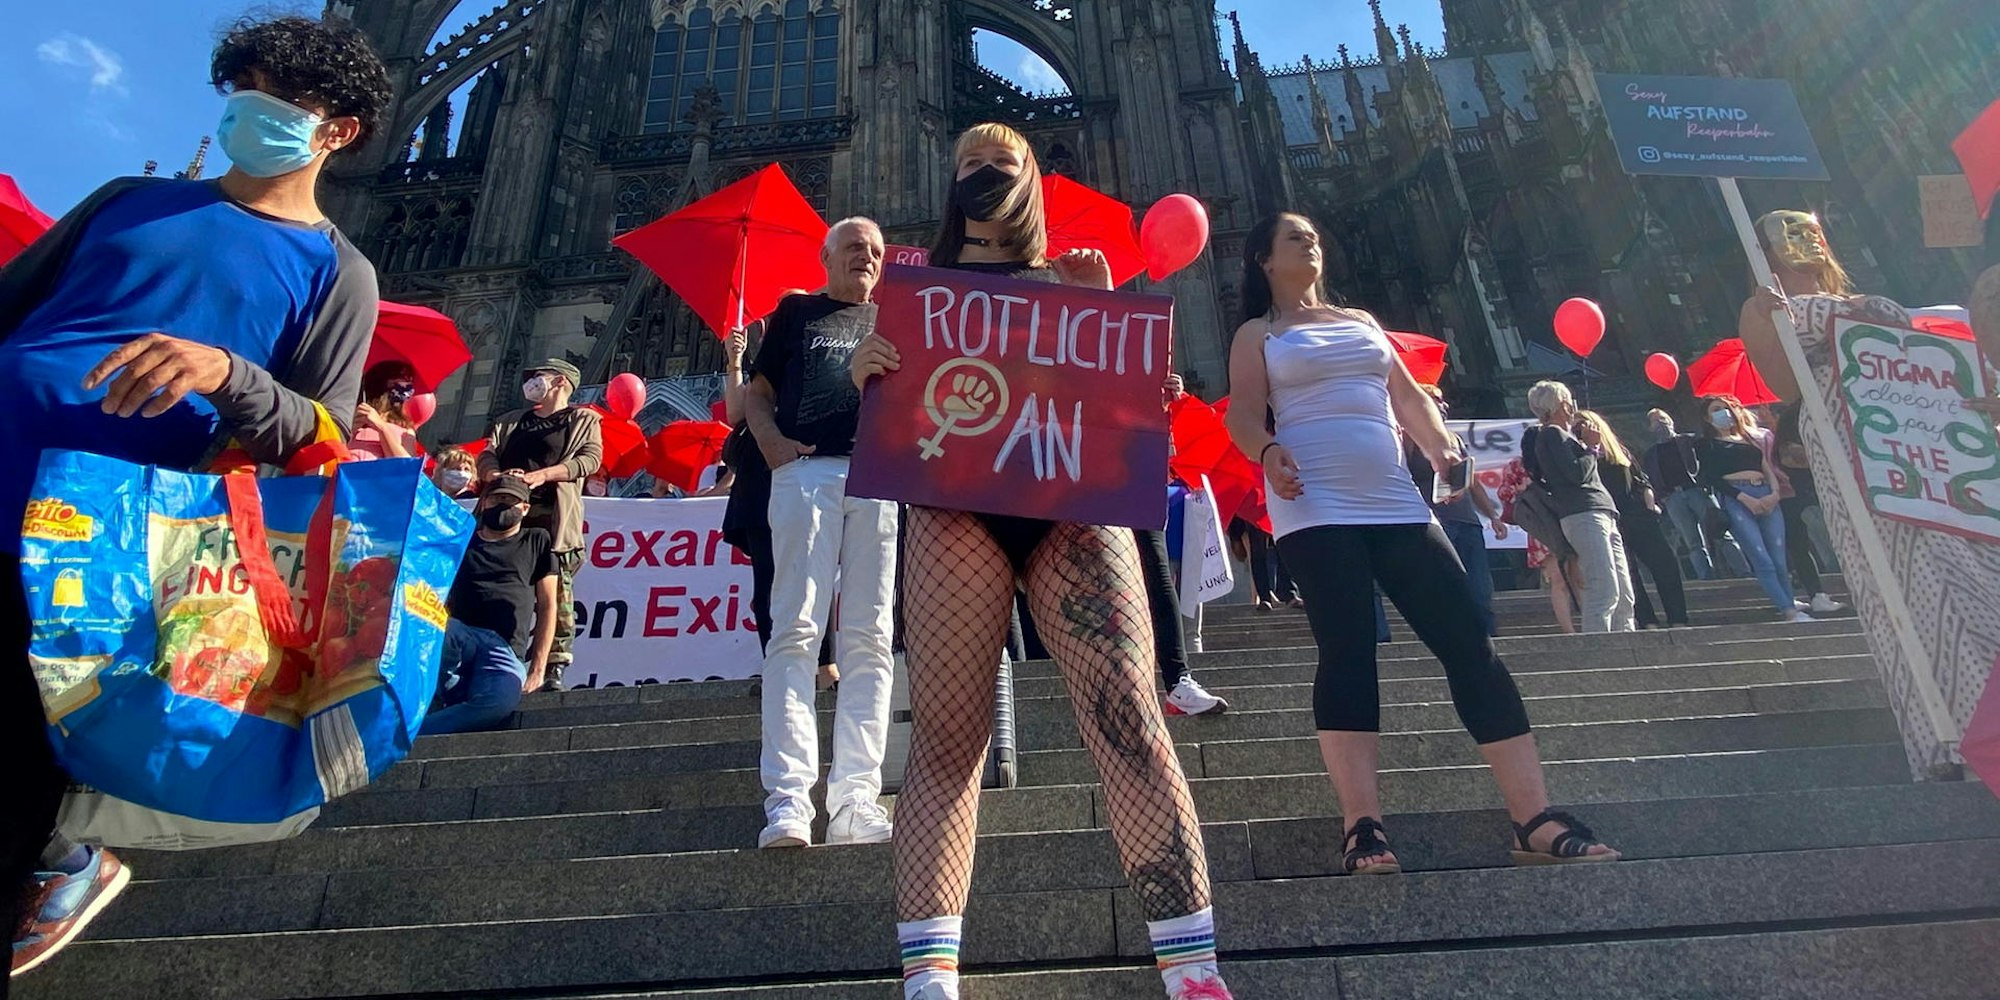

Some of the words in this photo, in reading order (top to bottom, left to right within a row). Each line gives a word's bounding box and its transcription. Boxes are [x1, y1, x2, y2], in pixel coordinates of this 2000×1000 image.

[1647, 105, 1748, 122] AUFSTAND
[916, 286, 1169, 376] ROTLICHT
[1858, 351, 1965, 390] STIGMA
[993, 392, 1082, 482] AN
[1898, 418, 1945, 442] pay
[1882, 438, 1950, 474] THE
[582, 520, 753, 568] exar
